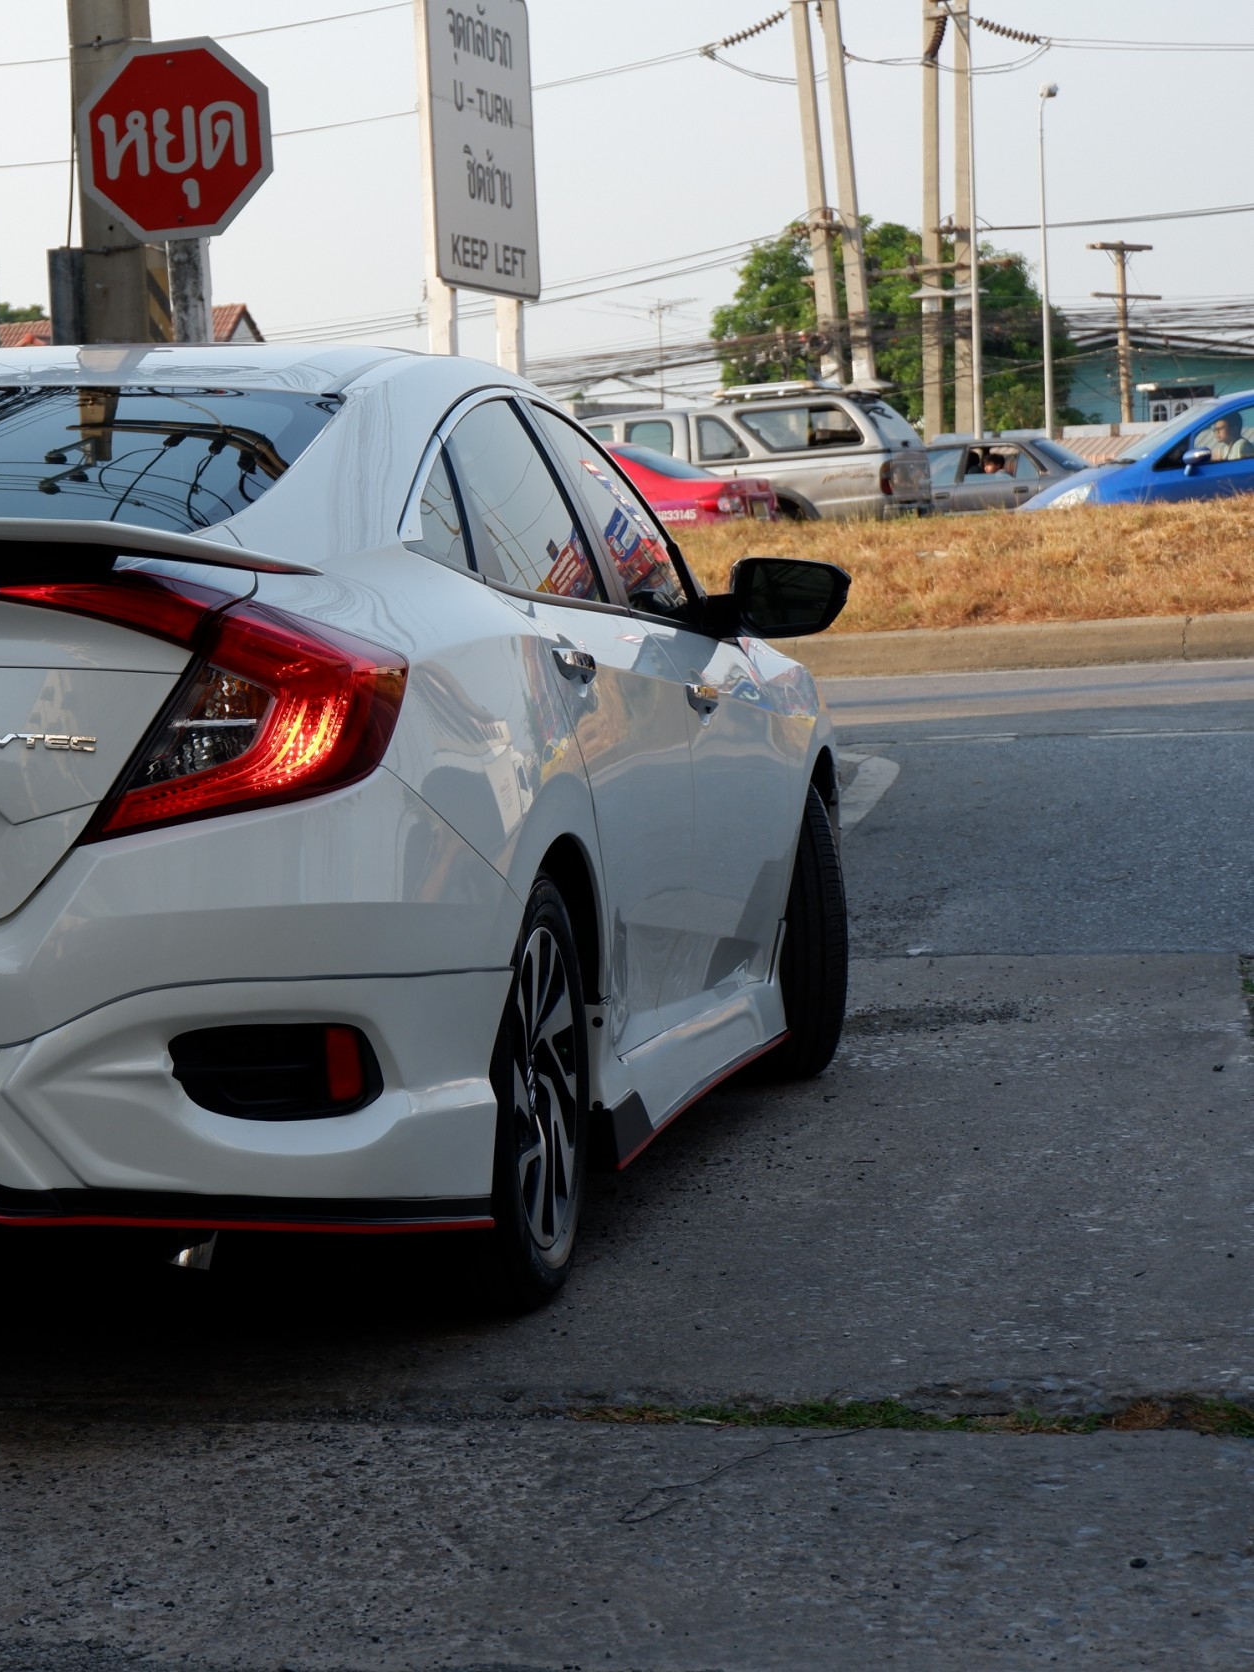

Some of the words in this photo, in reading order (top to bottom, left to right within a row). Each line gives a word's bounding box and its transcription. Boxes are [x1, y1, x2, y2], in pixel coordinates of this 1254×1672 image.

[447, 3, 512, 70] จุดกลับรถ
[98, 100, 247, 209] หยุด
[451, 232, 488, 270] KEEP
[494, 242, 526, 279] LEFT
